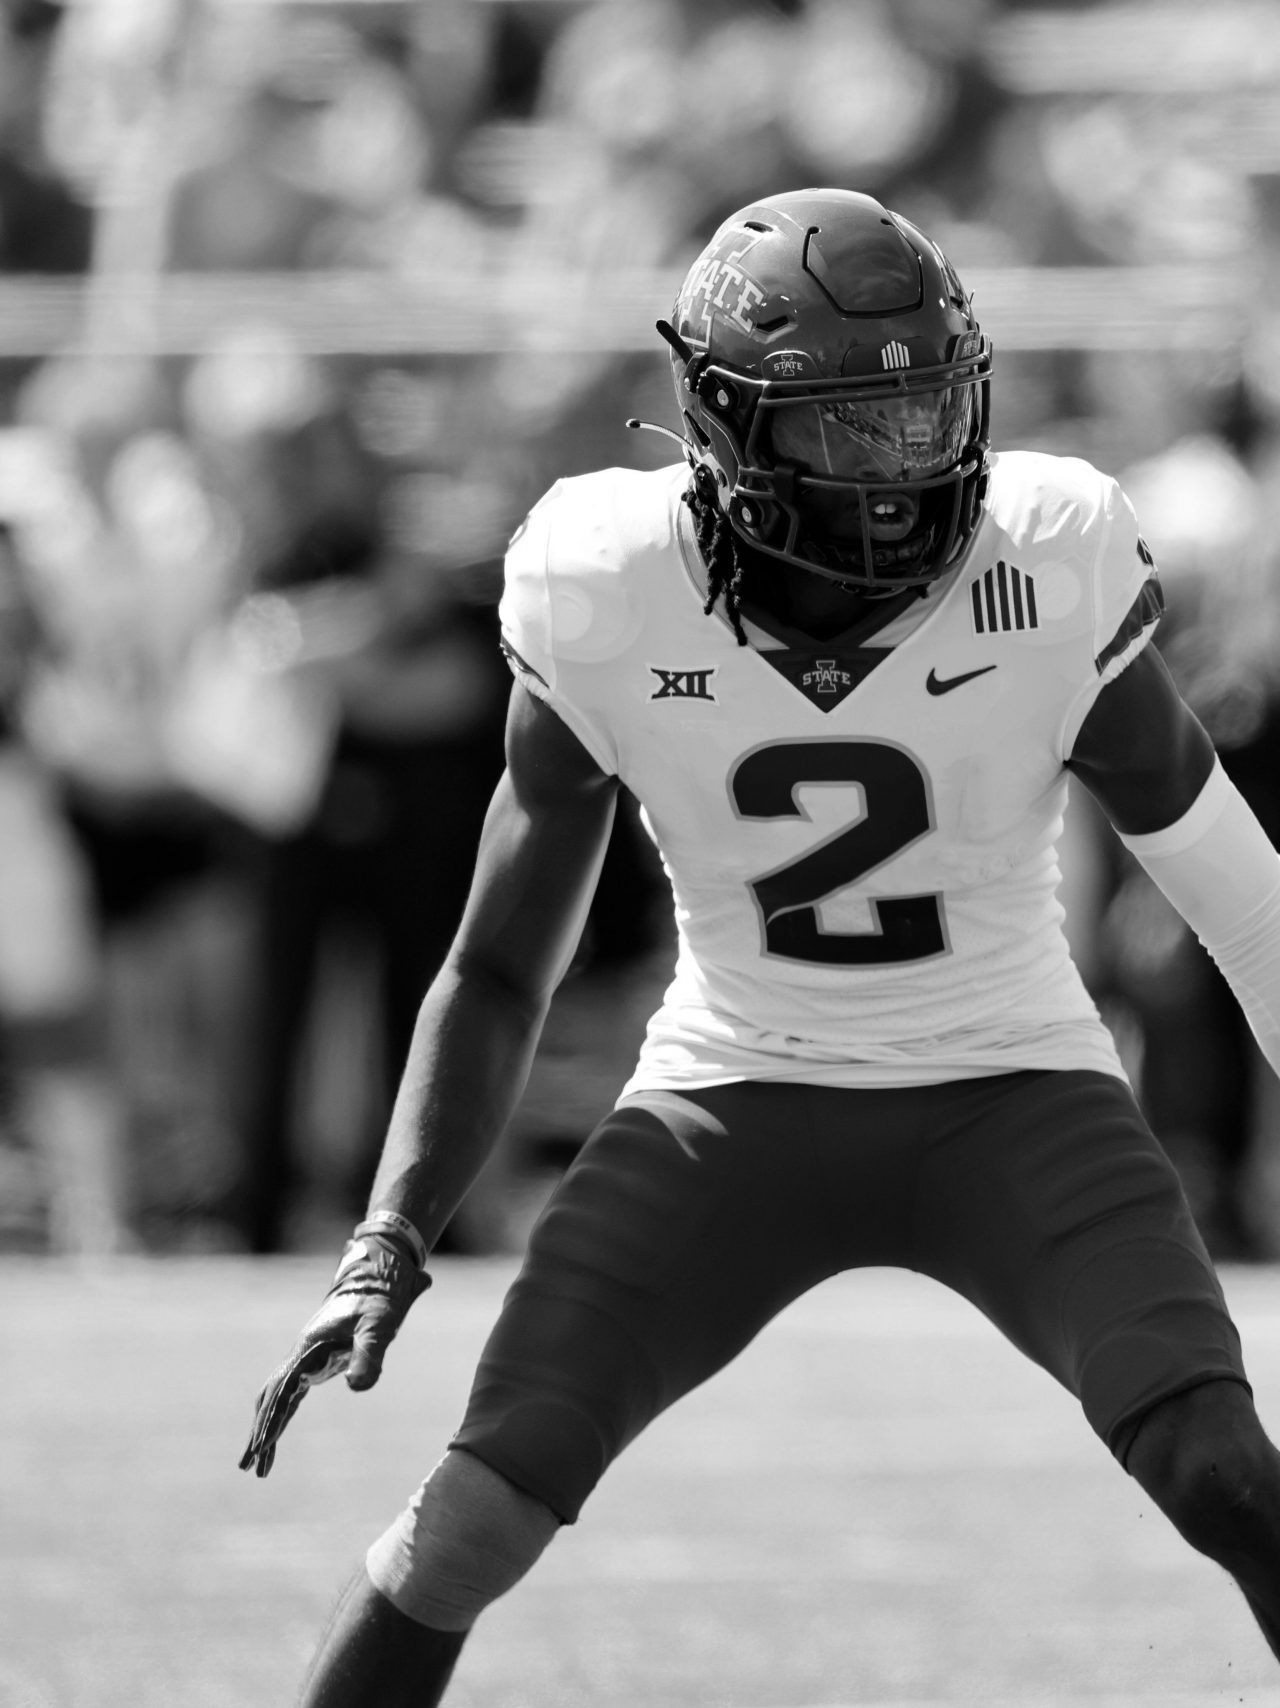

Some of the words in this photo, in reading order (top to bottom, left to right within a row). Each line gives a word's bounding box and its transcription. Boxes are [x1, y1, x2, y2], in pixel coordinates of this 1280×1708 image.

[773, 360, 803, 374] STATE
[650, 667, 716, 700] XII
[802, 669, 851, 687] STATE
[725, 734, 954, 970] 2
